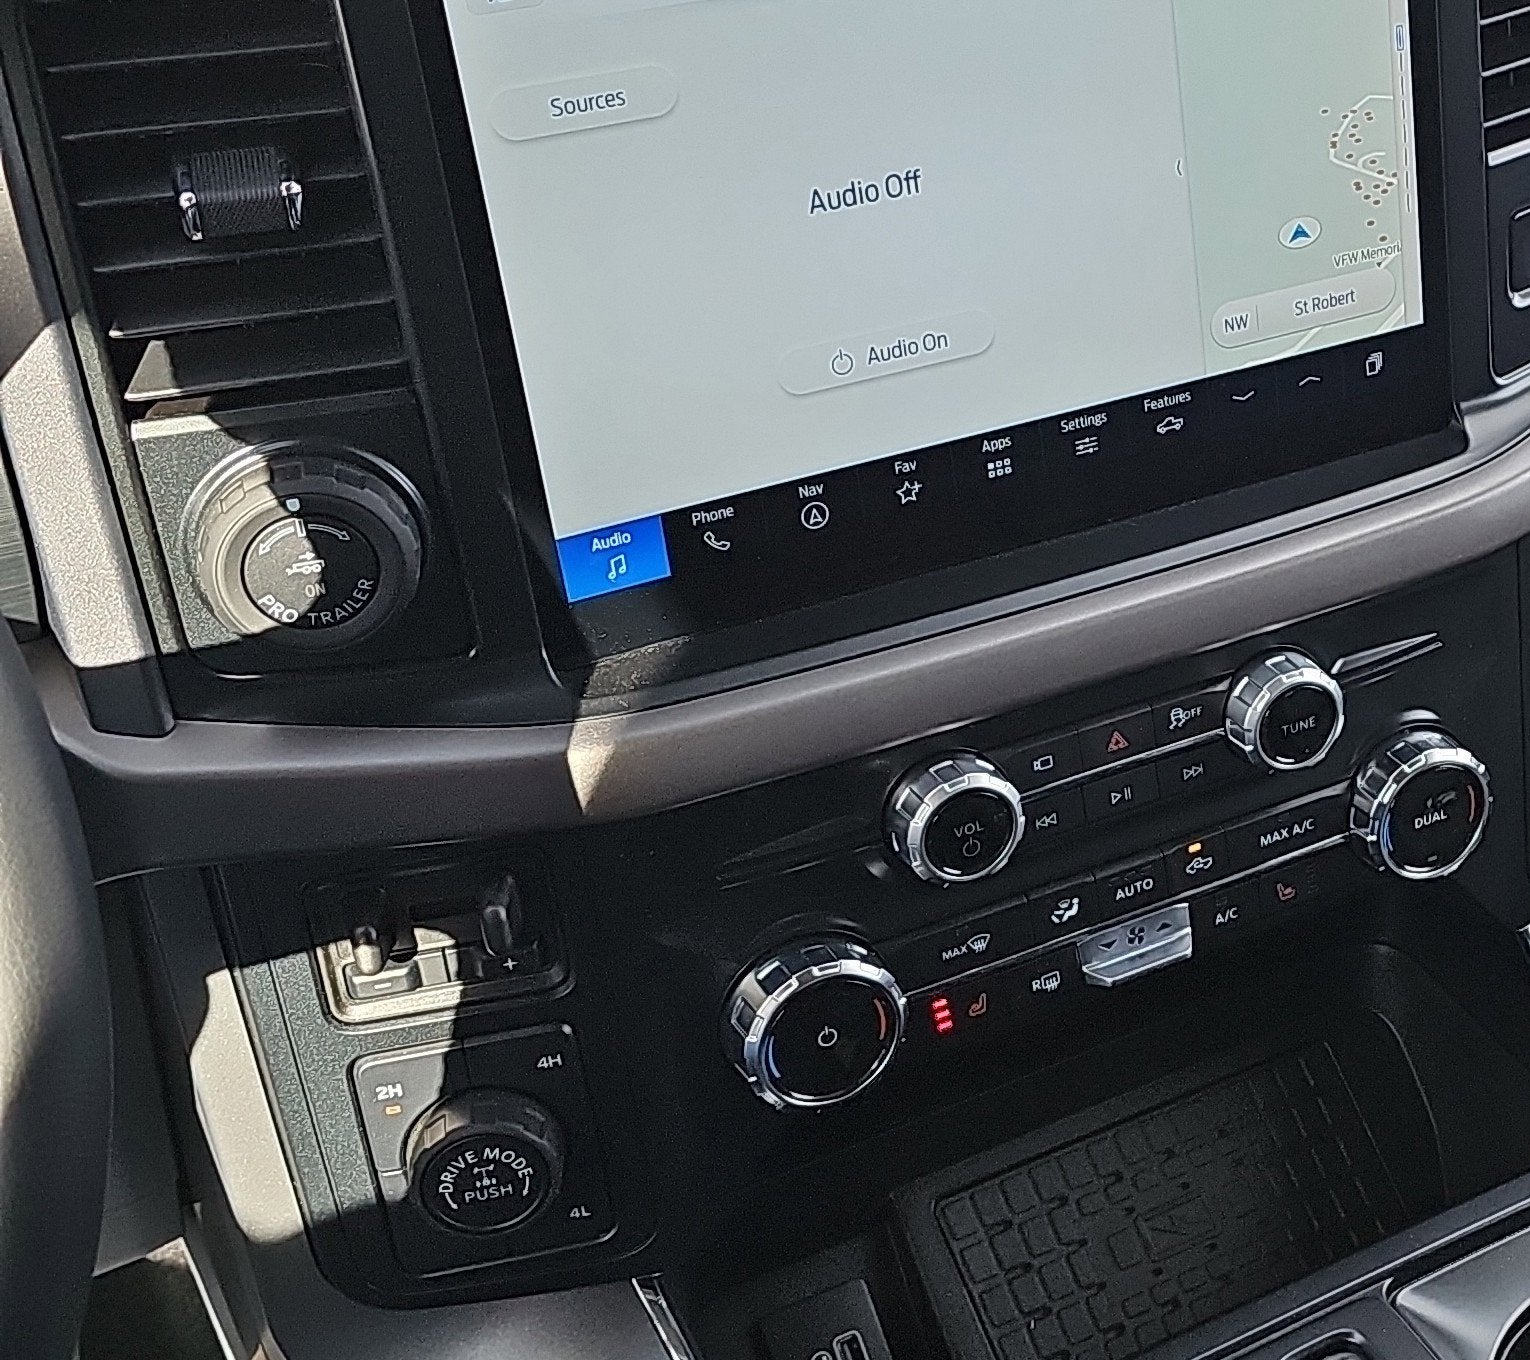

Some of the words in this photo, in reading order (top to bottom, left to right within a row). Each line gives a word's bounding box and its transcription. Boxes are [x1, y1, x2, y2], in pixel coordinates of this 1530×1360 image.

[550, 90, 627, 118] Sources
[809, 180, 880, 215] Audio
[884, 169, 923, 199] Off
[1333, 251, 1359, 268] VFW
[1361, 240, 1402, 261] Memori
[1294, 298, 1309, 318] St
[1311, 288, 1356, 312] Robert
[1223, 313, 1249, 333] NW
[867, 340, 919, 367] Audio
[921, 331, 949, 354] On
[1143, 390, 1192, 412] Features
[1060, 411, 1108, 433] Settings
[981, 435, 1012, 453] Apps
[894, 458, 917, 474] Fav
[798, 481, 824, 498] Nav
[691, 504, 734, 526] Phone
[590, 530, 631, 552] Audio
[305, 582, 326, 598] ON
[258, 593, 299, 624] PRO
[307, 578, 375, 626] TRAILER
[1183, 706, 1202, 720] OFF
[1281, 716, 1316, 736] TUNE
[953, 819, 985, 838] VOL
[1413, 808, 1448, 830] DUAL
[1260, 826, 1290, 848] MAX
[1292, 817, 1316, 837] A/C
[1115, 878, 1154, 901] AUTO
[1214, 906, 1239, 926] A/C
[941, 943, 968, 961] MAX
[536, 1053, 562, 1069] 4H
[375, 1083, 403, 1101] 2H
[438, 1148, 479, 1195] DRIVE
[482, 1146, 534, 1179] MODE
[464, 1183, 514, 1204] PUSH
[569, 1205, 591, 1219] 4L
